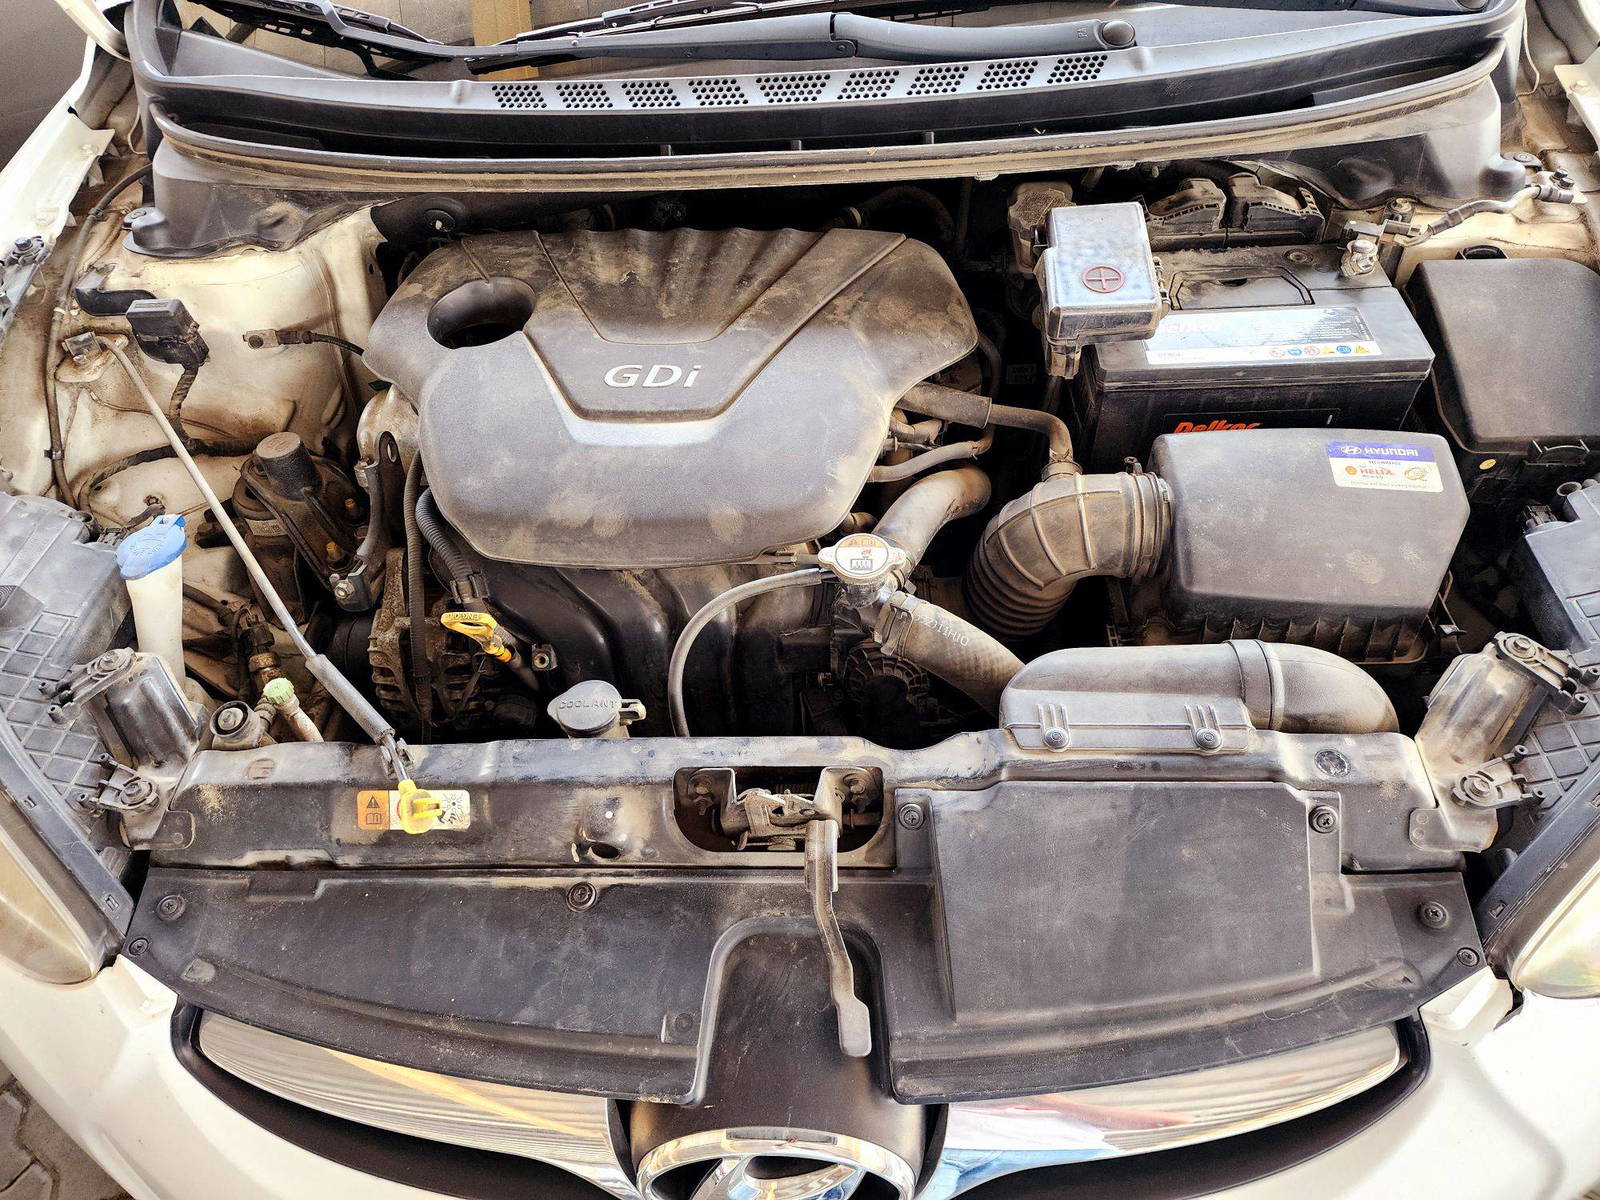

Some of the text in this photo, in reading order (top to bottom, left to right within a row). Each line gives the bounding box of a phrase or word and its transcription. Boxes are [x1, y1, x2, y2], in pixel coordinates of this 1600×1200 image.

[604, 364, 702, 389] GDi
[1364, 447, 1419, 457] HYUNDAI
[559, 699, 618, 710] COOLANT
